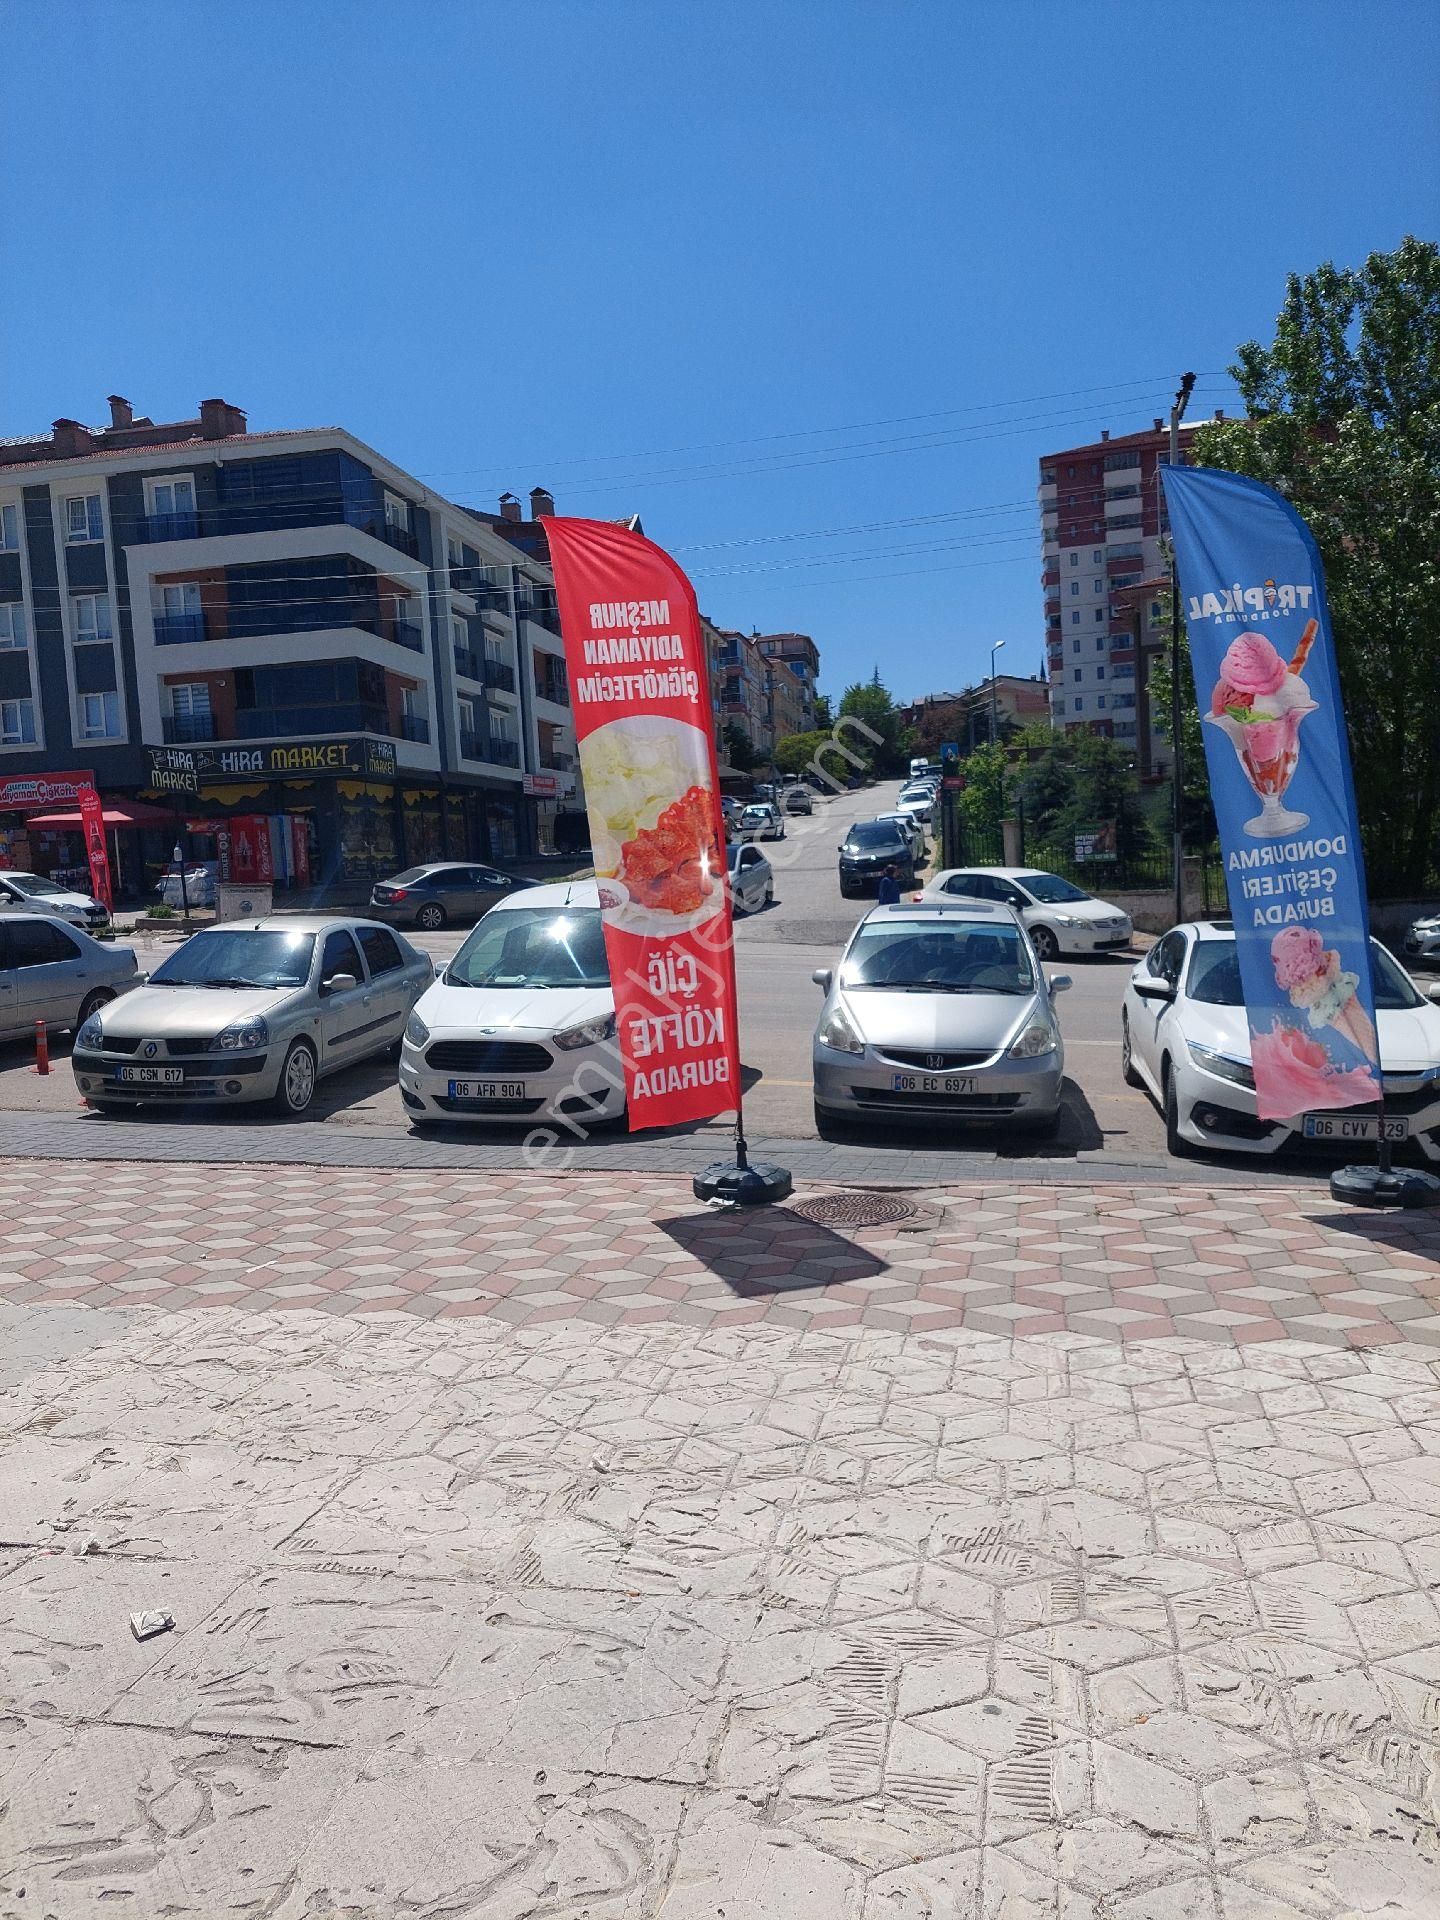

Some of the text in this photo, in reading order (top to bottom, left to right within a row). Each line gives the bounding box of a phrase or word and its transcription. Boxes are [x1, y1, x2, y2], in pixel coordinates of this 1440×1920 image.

[271, 745, 349, 769] MARKET
[6, 782, 36, 792] gurme
[151, 769, 198, 791] MARKET
[122, 1068, 182, 1082] 06 CSN 617
[456, 1083, 522, 1097] 06 AFR 904
[902, 1077, 973, 1092] 06 EC 6971
[1315, 1121, 1333, 1135] 06
[1378, 1123, 1404, 1138] 29
